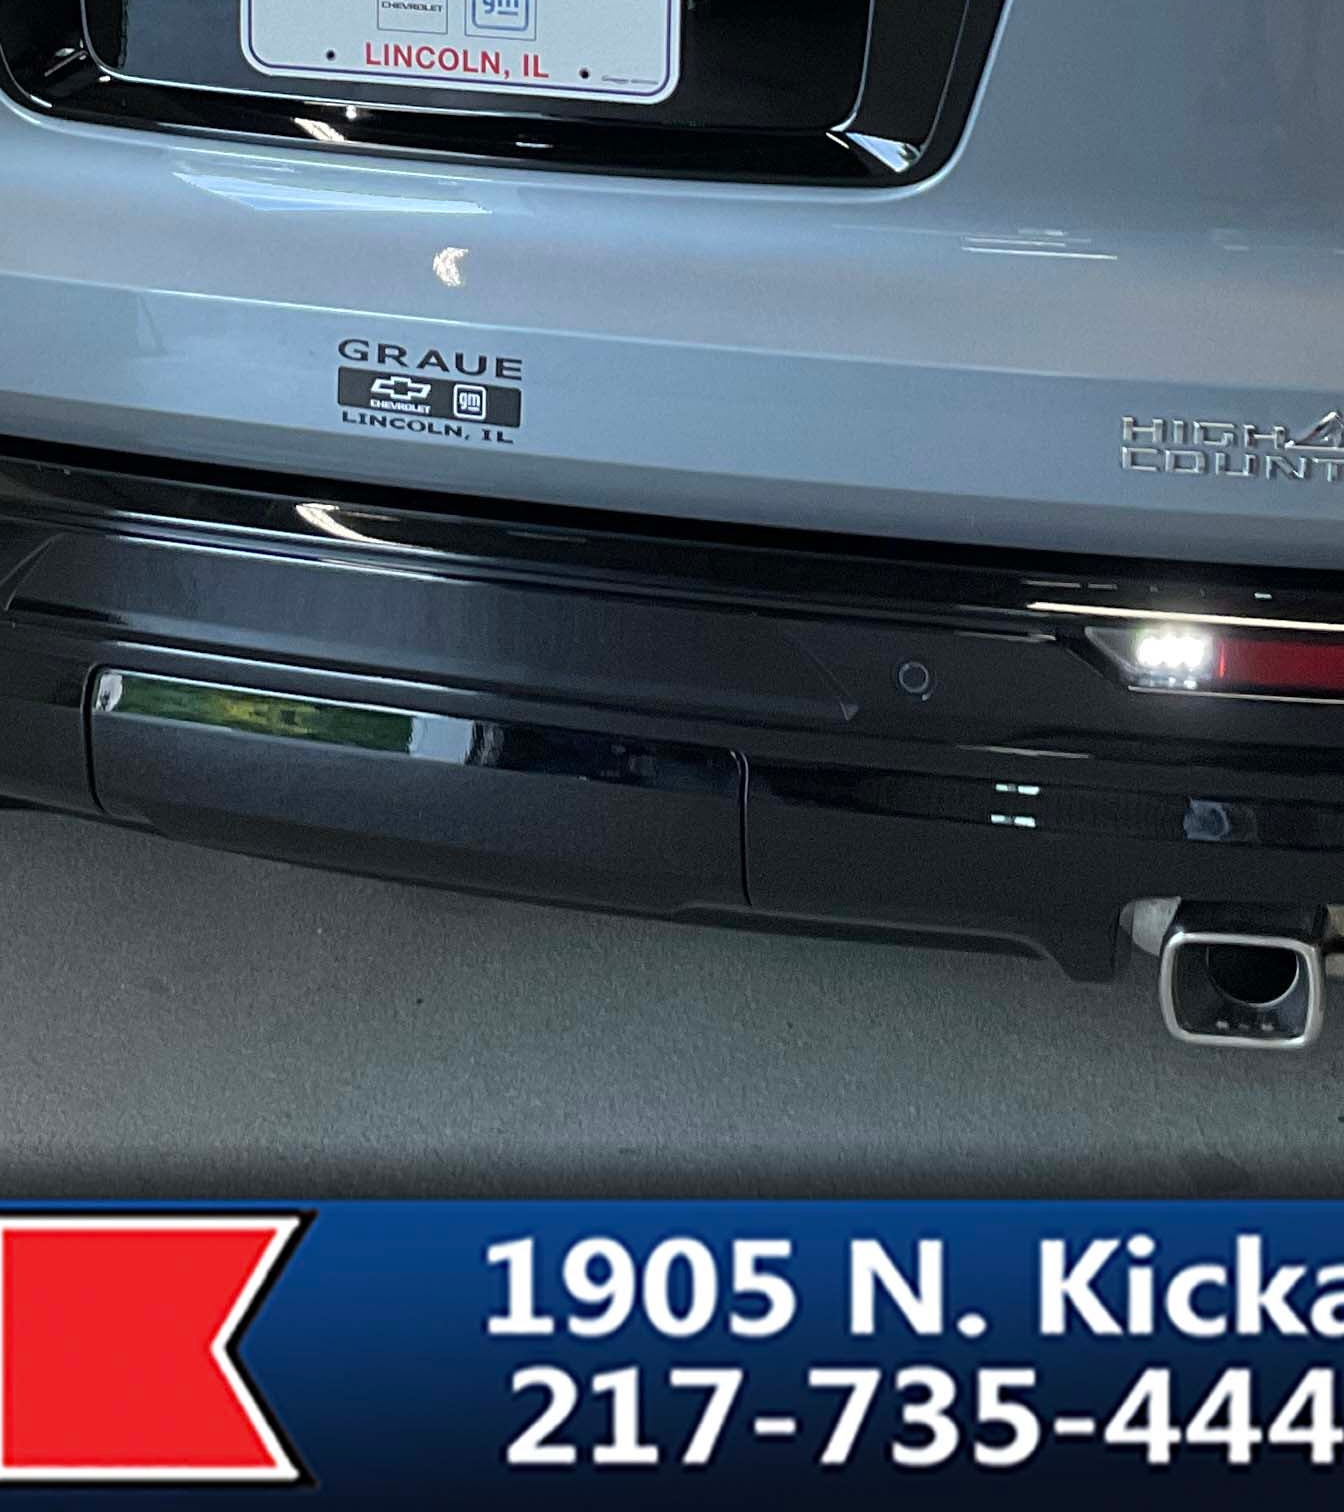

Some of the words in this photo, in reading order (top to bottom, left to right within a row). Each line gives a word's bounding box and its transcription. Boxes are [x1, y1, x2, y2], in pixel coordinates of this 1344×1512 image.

[380, 0, 444, 14] CHEVROLET
[365, 41, 510, 79] LINCOLN,
[522, 56, 550, 79] IL
[337, 338, 523, 381] GRAUE
[370, 398, 432, 415] CHEVROLET
[459, 391, 481, 412] gm
[342, 410, 471, 440] LINCOLN,
[480, 428, 514, 444] IL
[1120, 415, 1289, 450] HIGH
